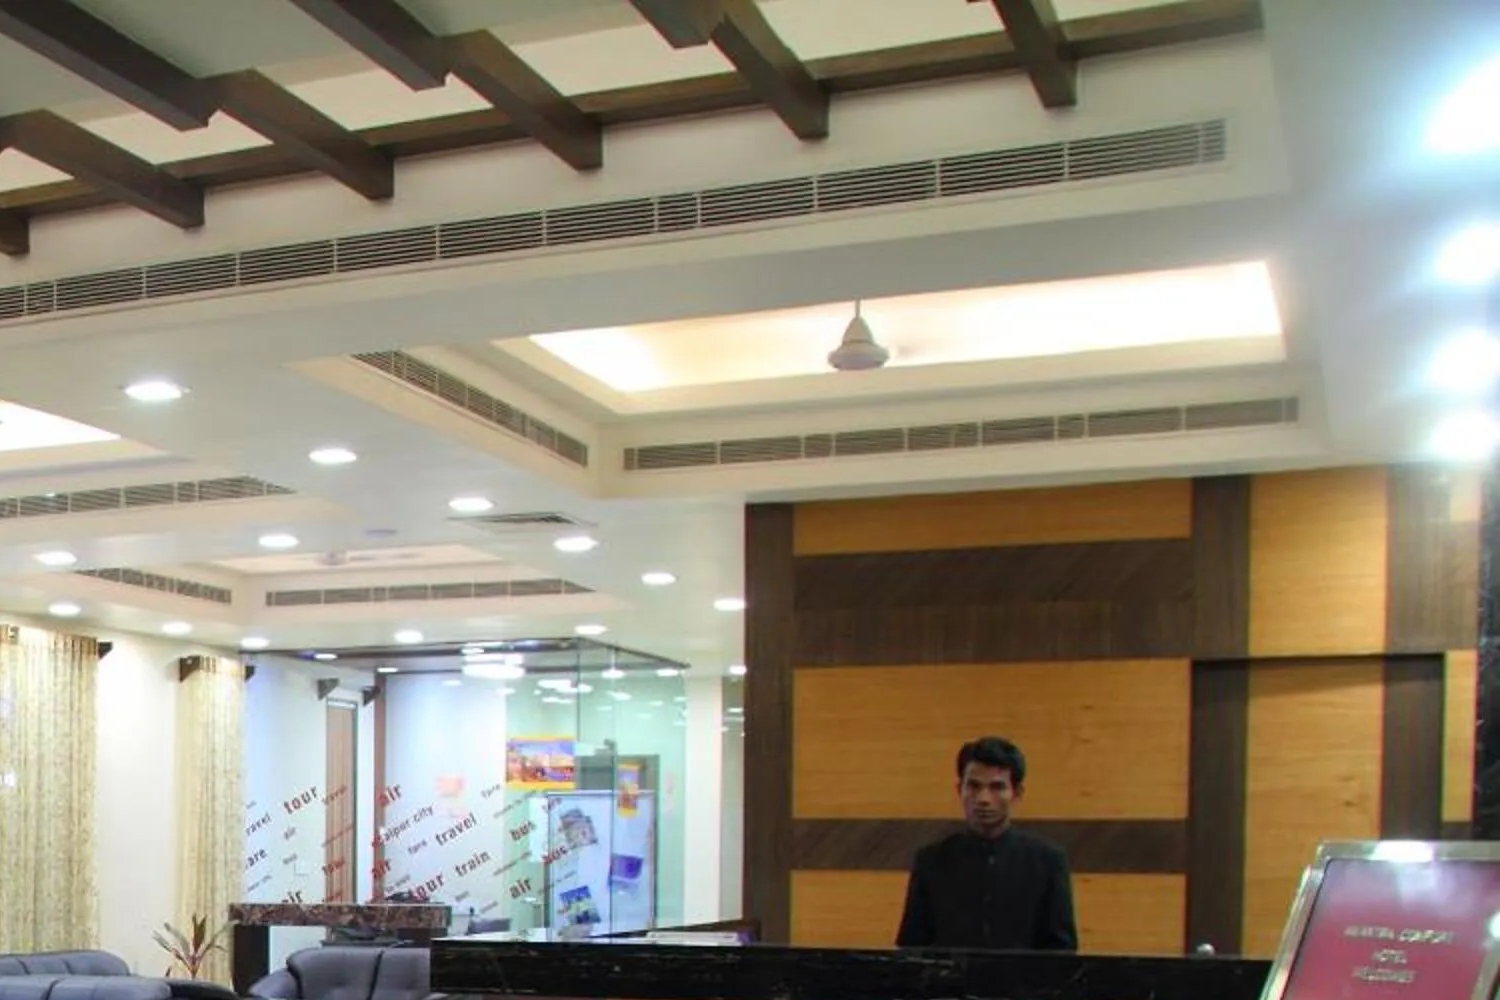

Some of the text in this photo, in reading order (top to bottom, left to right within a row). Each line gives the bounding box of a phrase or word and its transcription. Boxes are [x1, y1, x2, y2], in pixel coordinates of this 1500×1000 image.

[283, 786, 318, 815] tour
[377, 784, 402, 807] air
[246, 812, 272, 835] ravel
[435, 812, 478, 846] travel
[246, 849, 267, 869] are
[455, 851, 491, 878] train
[408, 873, 444, 900] tour
[509, 878, 532, 899] air
